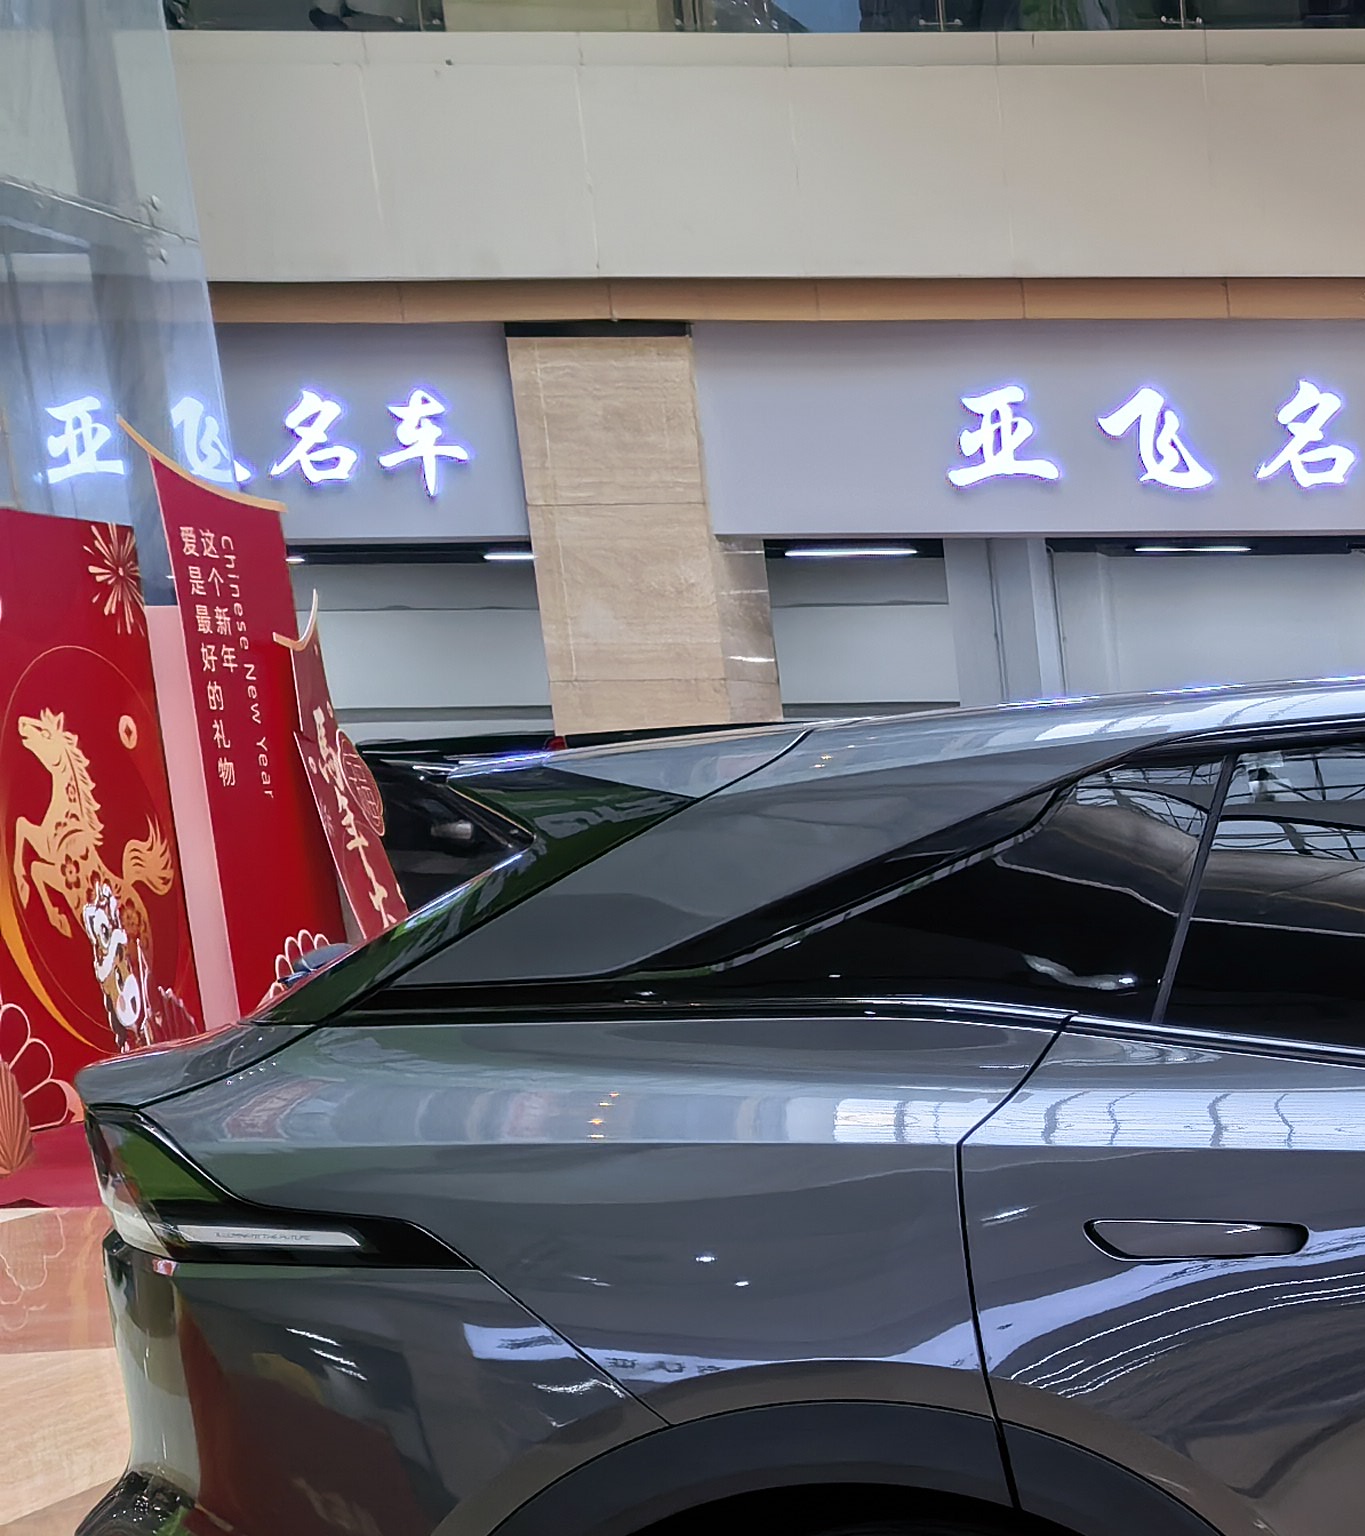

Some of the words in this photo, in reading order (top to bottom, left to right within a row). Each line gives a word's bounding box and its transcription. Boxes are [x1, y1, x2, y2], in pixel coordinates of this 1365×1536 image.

[46, 389, 470, 497] 亚飞名车
[178, 525, 237, 788] 爱是最好的礼物
[199, 528, 239, 673] 这个新年
[220, 535, 250, 650] Chinese
[244, 663, 262, 725] New
[256, 736, 275, 799] Year
